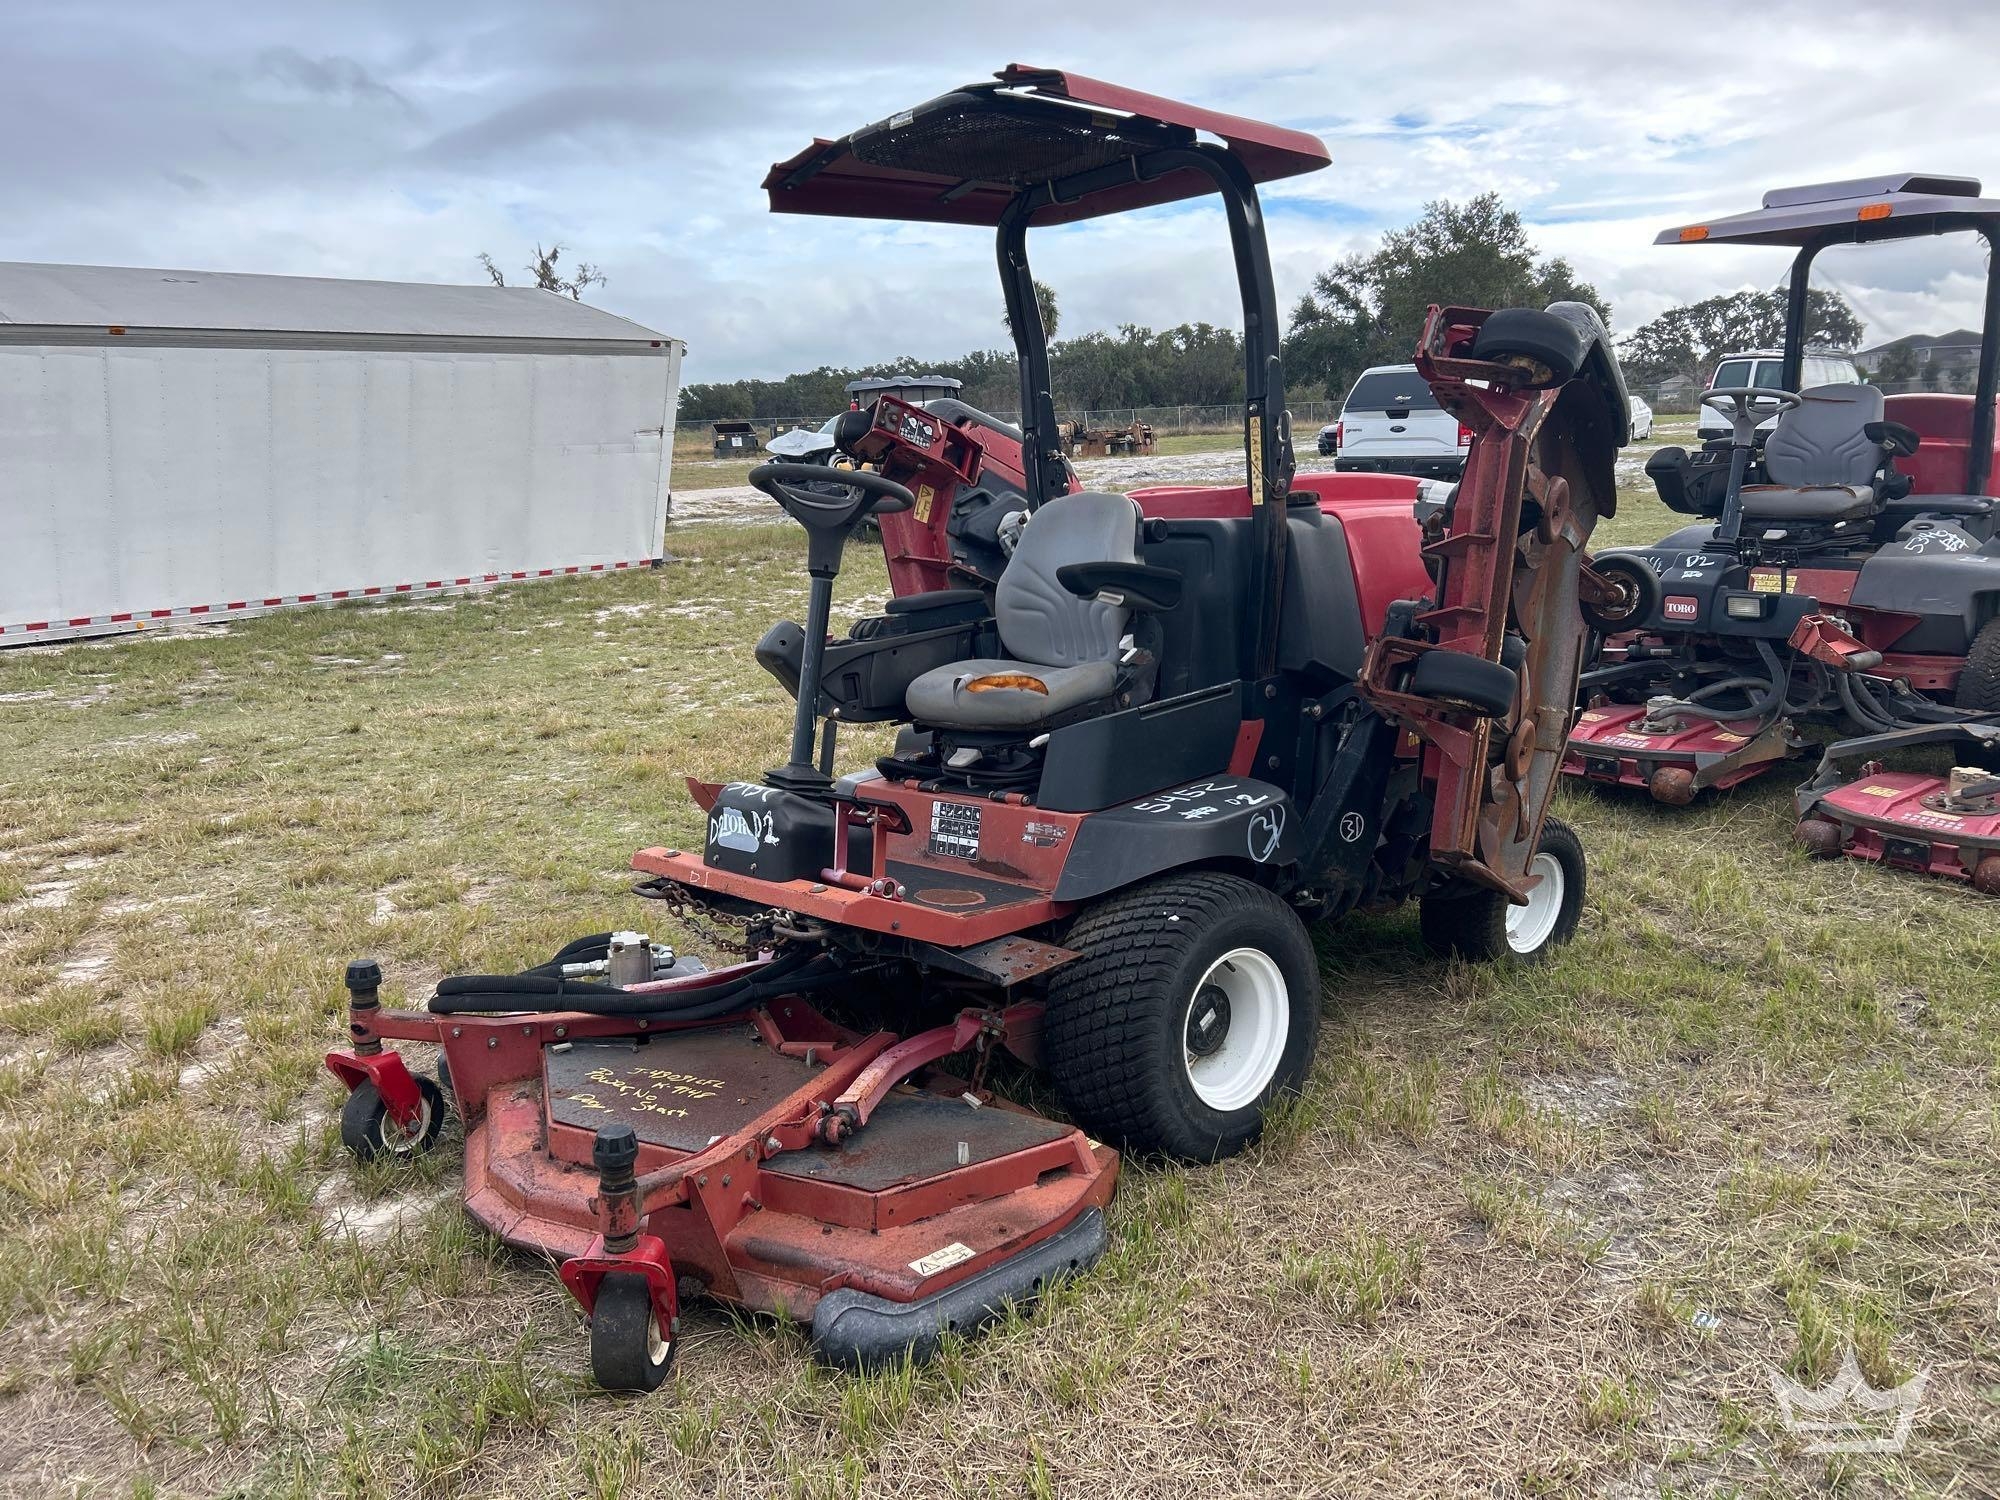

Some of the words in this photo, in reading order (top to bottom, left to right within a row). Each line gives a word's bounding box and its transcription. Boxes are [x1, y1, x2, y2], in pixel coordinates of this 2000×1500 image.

[1685, 555, 1715, 568] D2
[1666, 602, 1696, 614] TORO
[1132, 782, 1238, 813] 5452
[632, 1088, 658, 1101] No
[630, 1101, 689, 1119] Start
